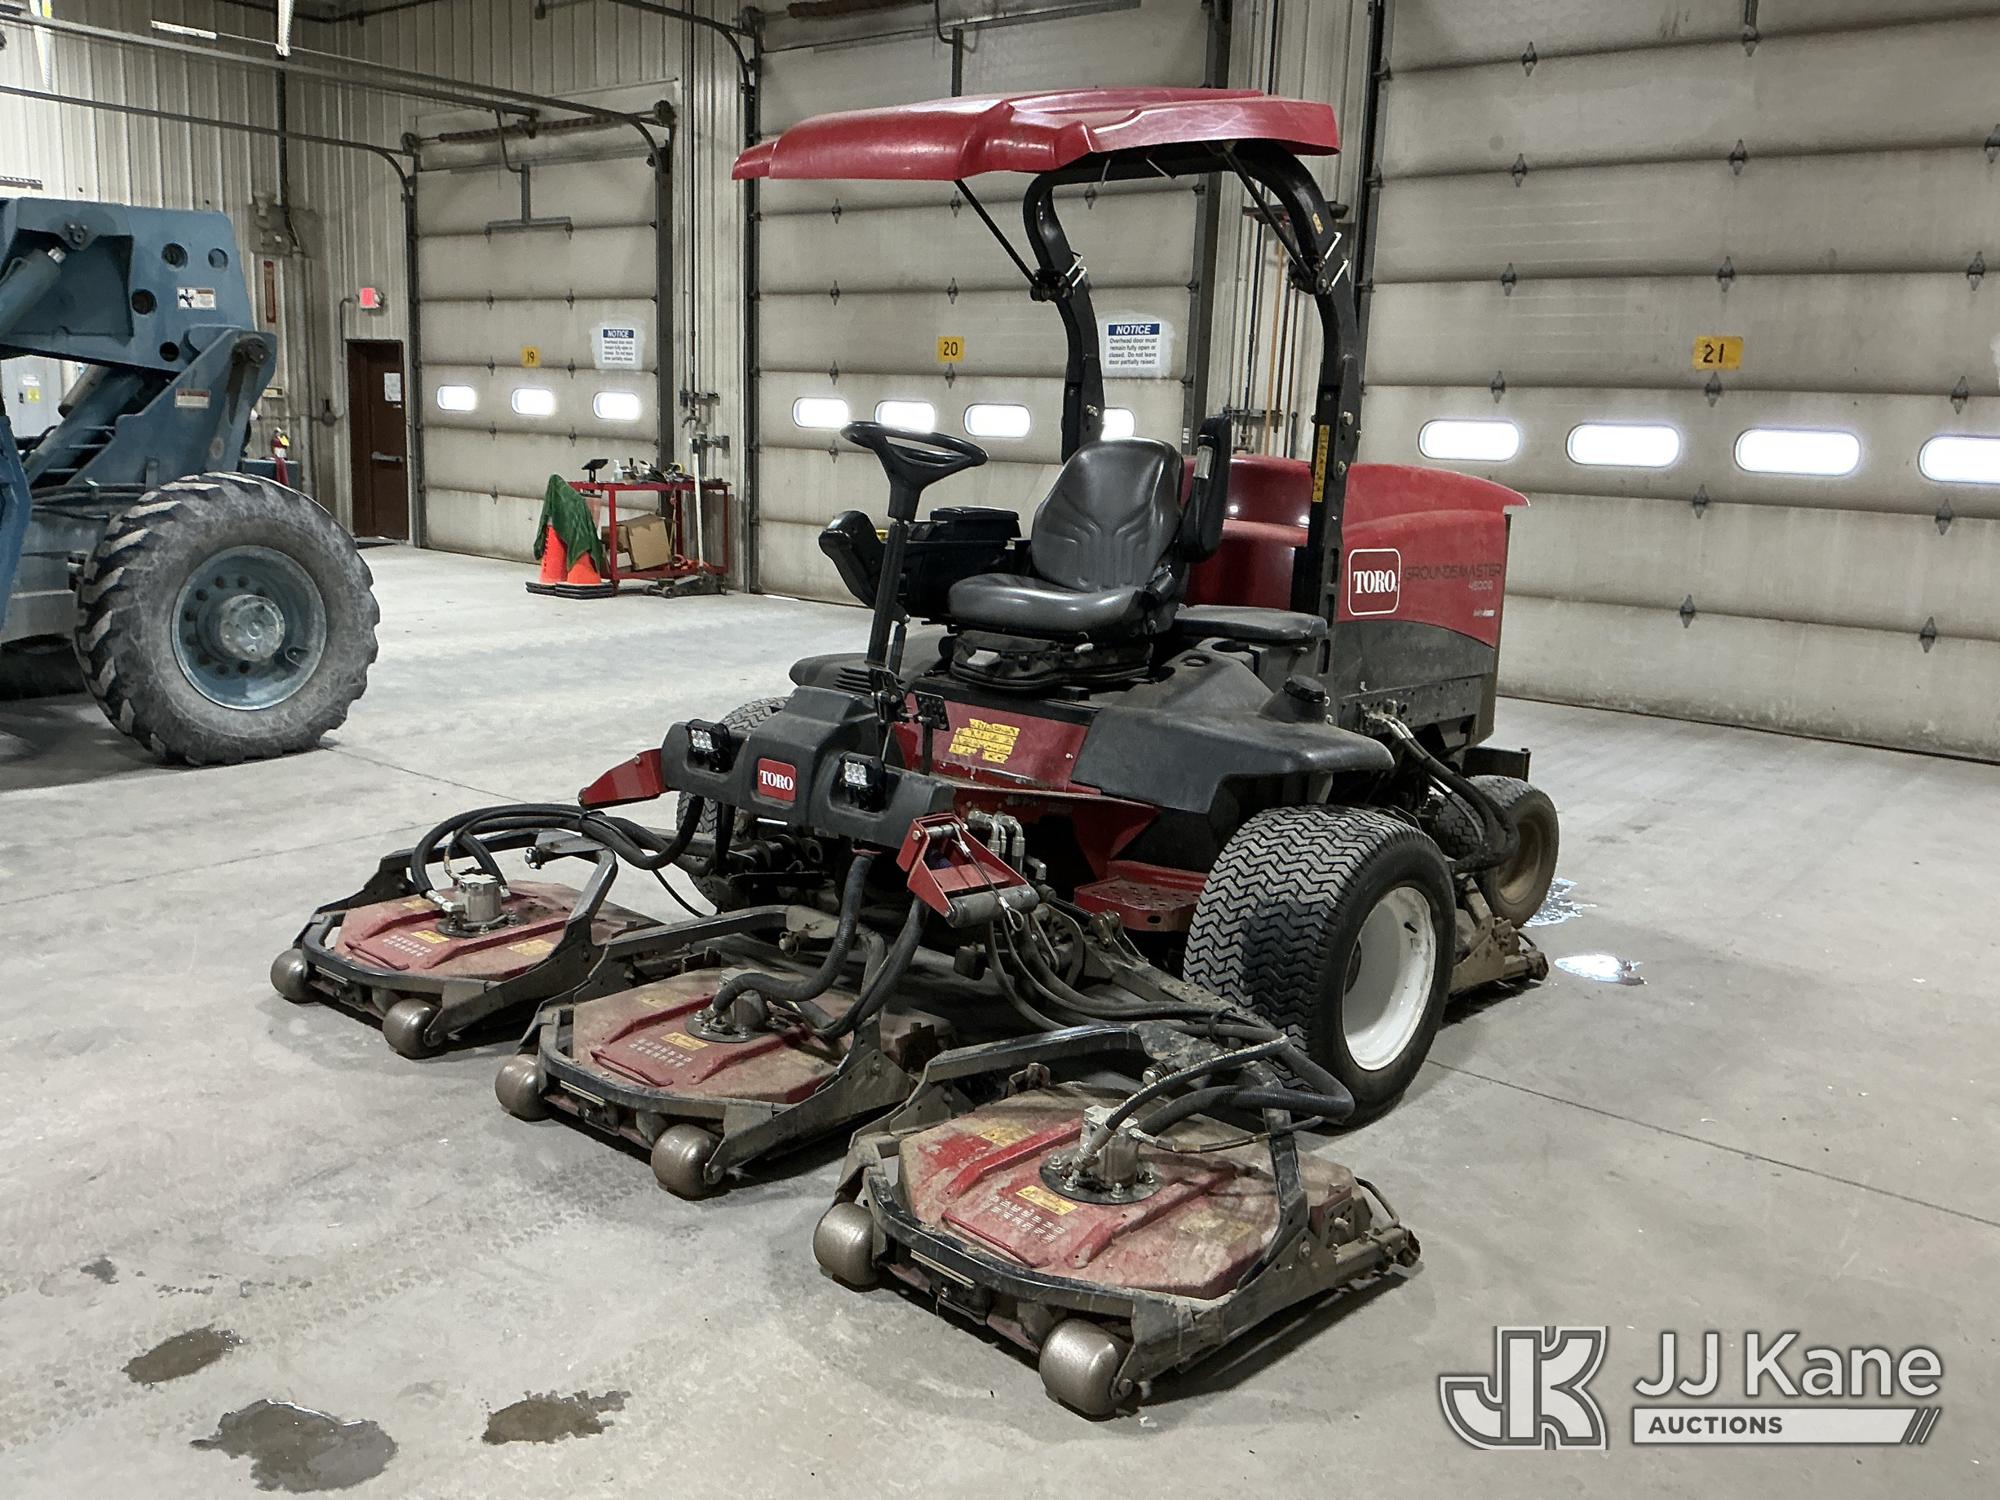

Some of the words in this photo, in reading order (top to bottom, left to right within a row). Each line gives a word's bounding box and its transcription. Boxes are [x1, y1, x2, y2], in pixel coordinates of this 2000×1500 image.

[607, 330, 630, 338] NOTICE
[1116, 325, 1151, 335] NOTICE
[944, 341, 958, 356] 20
[1703, 343, 1724, 363] 21
[527, 351, 534, 363] 19
[1353, 570, 1396, 594] TORO
[760, 770, 794, 791] TORO
